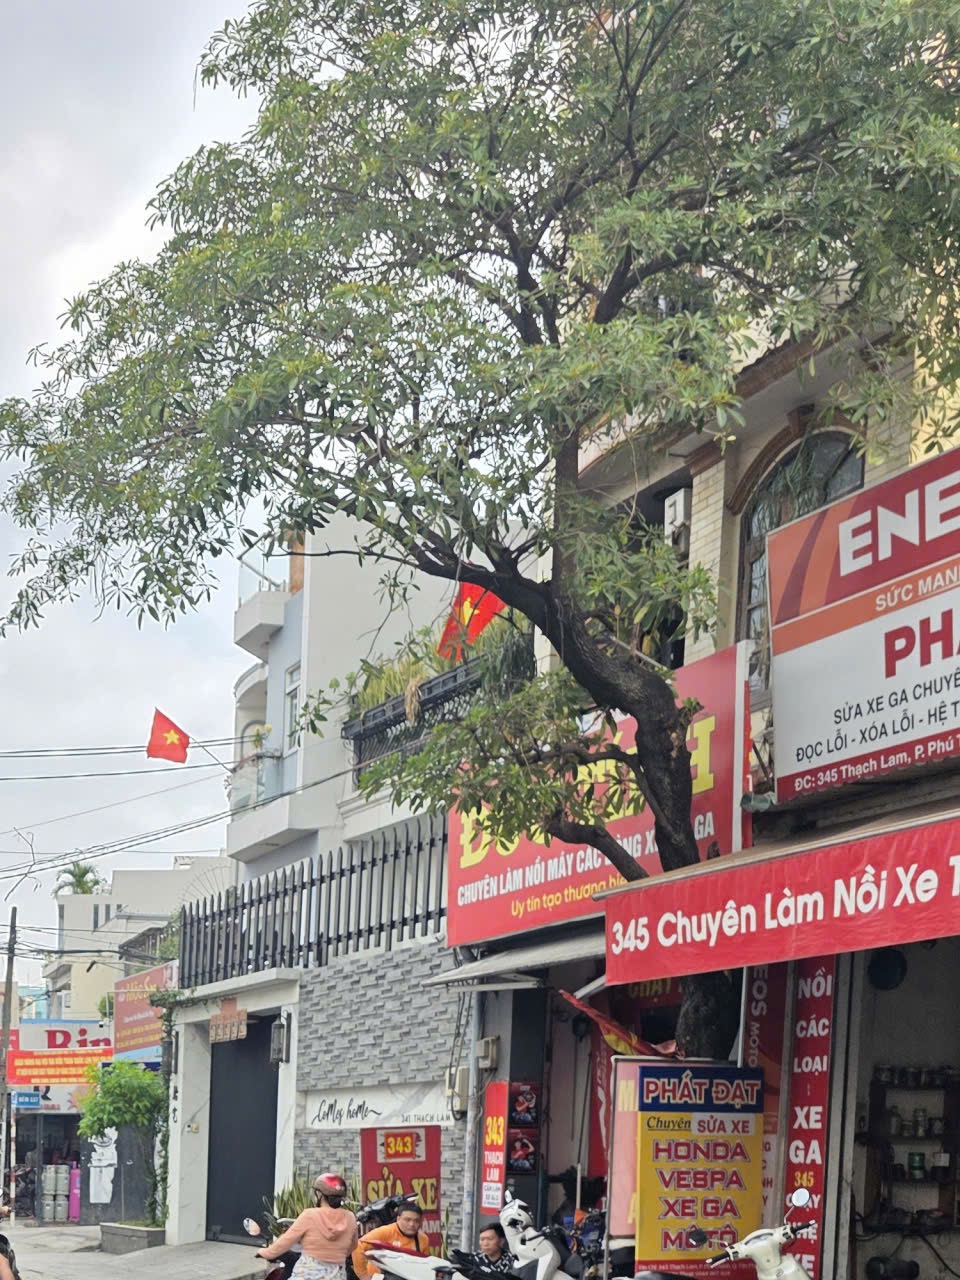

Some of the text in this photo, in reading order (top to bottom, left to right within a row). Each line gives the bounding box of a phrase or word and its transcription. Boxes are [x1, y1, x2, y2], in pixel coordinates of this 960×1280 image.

[839, 470, 960, 577] ENE
[875, 582, 914, 611] SỨC
[884, 608, 960, 680] PH
[833, 702, 863, 725] SỬA
[866, 696, 884, 715] XE
[888, 689, 909, 708] GA
[796, 741, 824, 764] ĐỌC
[827, 728, 848, 753] LỖI
[859, 720, 888, 745] XÓA
[892, 708, 915, 735] LỖI
[927, 701, 948, 726] HỆ
[795, 775, 816, 791] ĐC:
[817, 769, 838, 785] 345
[840, 757, 878, 779] Thạch
[881, 750, 912, 768] Lam,
[914, 744, 926, 760] P.
[928, 735, 954, 757] Phú
[457, 873, 498, 906] CHUYÊN
[499, 867, 523, 894] LÀM
[547, 850, 574, 881] MÁY
[645, 829, 659, 855] X
[694, 811, 714, 840] GA
[542, 890, 562, 911] tạo
[612, 917, 649, 955] 345
[657, 899, 757, 947] Chuyên
[764, 887, 824, 930] Làm
[834, 863, 887, 917] Nồi
[893, 863, 938, 907] Xe
[798, 966, 833, 999] NỒI
[796, 1014, 830, 1038] CÁC
[793, 1055, 828, 1076] LOẠI
[643, 1069, 709, 1103] PHÁT
[711, 1078, 761, 1108] ĐẠT
[486, 1116, 504, 1146] 343
[646, 1115, 750, 1134] Chuyên SỬA XE
[793, 1106, 823, 1130] XE
[387, 1136, 412, 1154] 343
[652, 1139, 751, 1162] HONDA
[789, 1139, 823, 1165] GA
[486, 1171, 500, 1181] LAM
[655, 1167, 746, 1191] VESPA
[794, 1171, 814, 1188] 345
[411, 1178, 438, 1210] XE
[658, 1196, 740, 1220] XE GA
